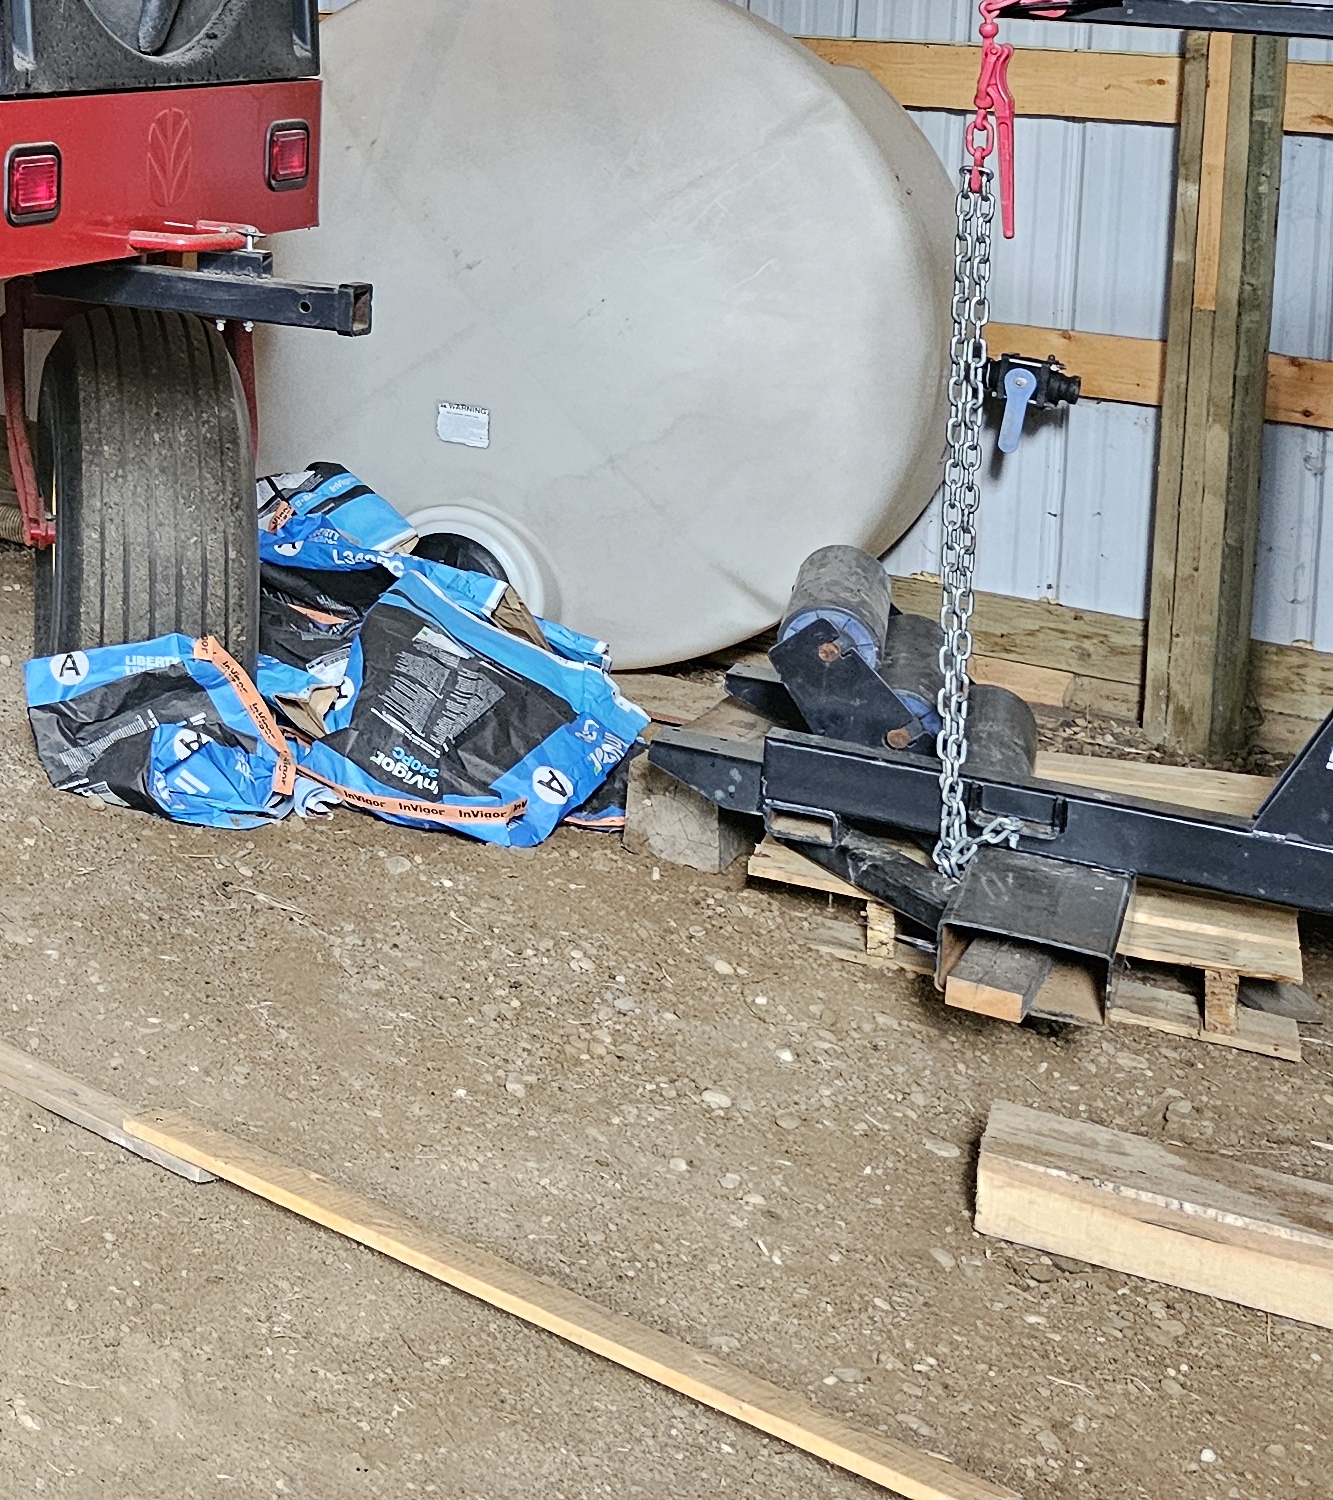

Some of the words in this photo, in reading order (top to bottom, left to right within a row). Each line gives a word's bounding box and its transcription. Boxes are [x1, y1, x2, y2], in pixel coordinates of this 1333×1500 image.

[448, 403, 488, 415] WARNING
[59, 653, 82, 677] A
[369, 750, 439, 795] InVigor
[392, 746, 440, 778] 340PC
[537, 770, 569, 798] A
[343, 790, 387, 808] InVigor
[398, 802, 446, 816] InVigor
[459, 809, 508, 821] InVigor
